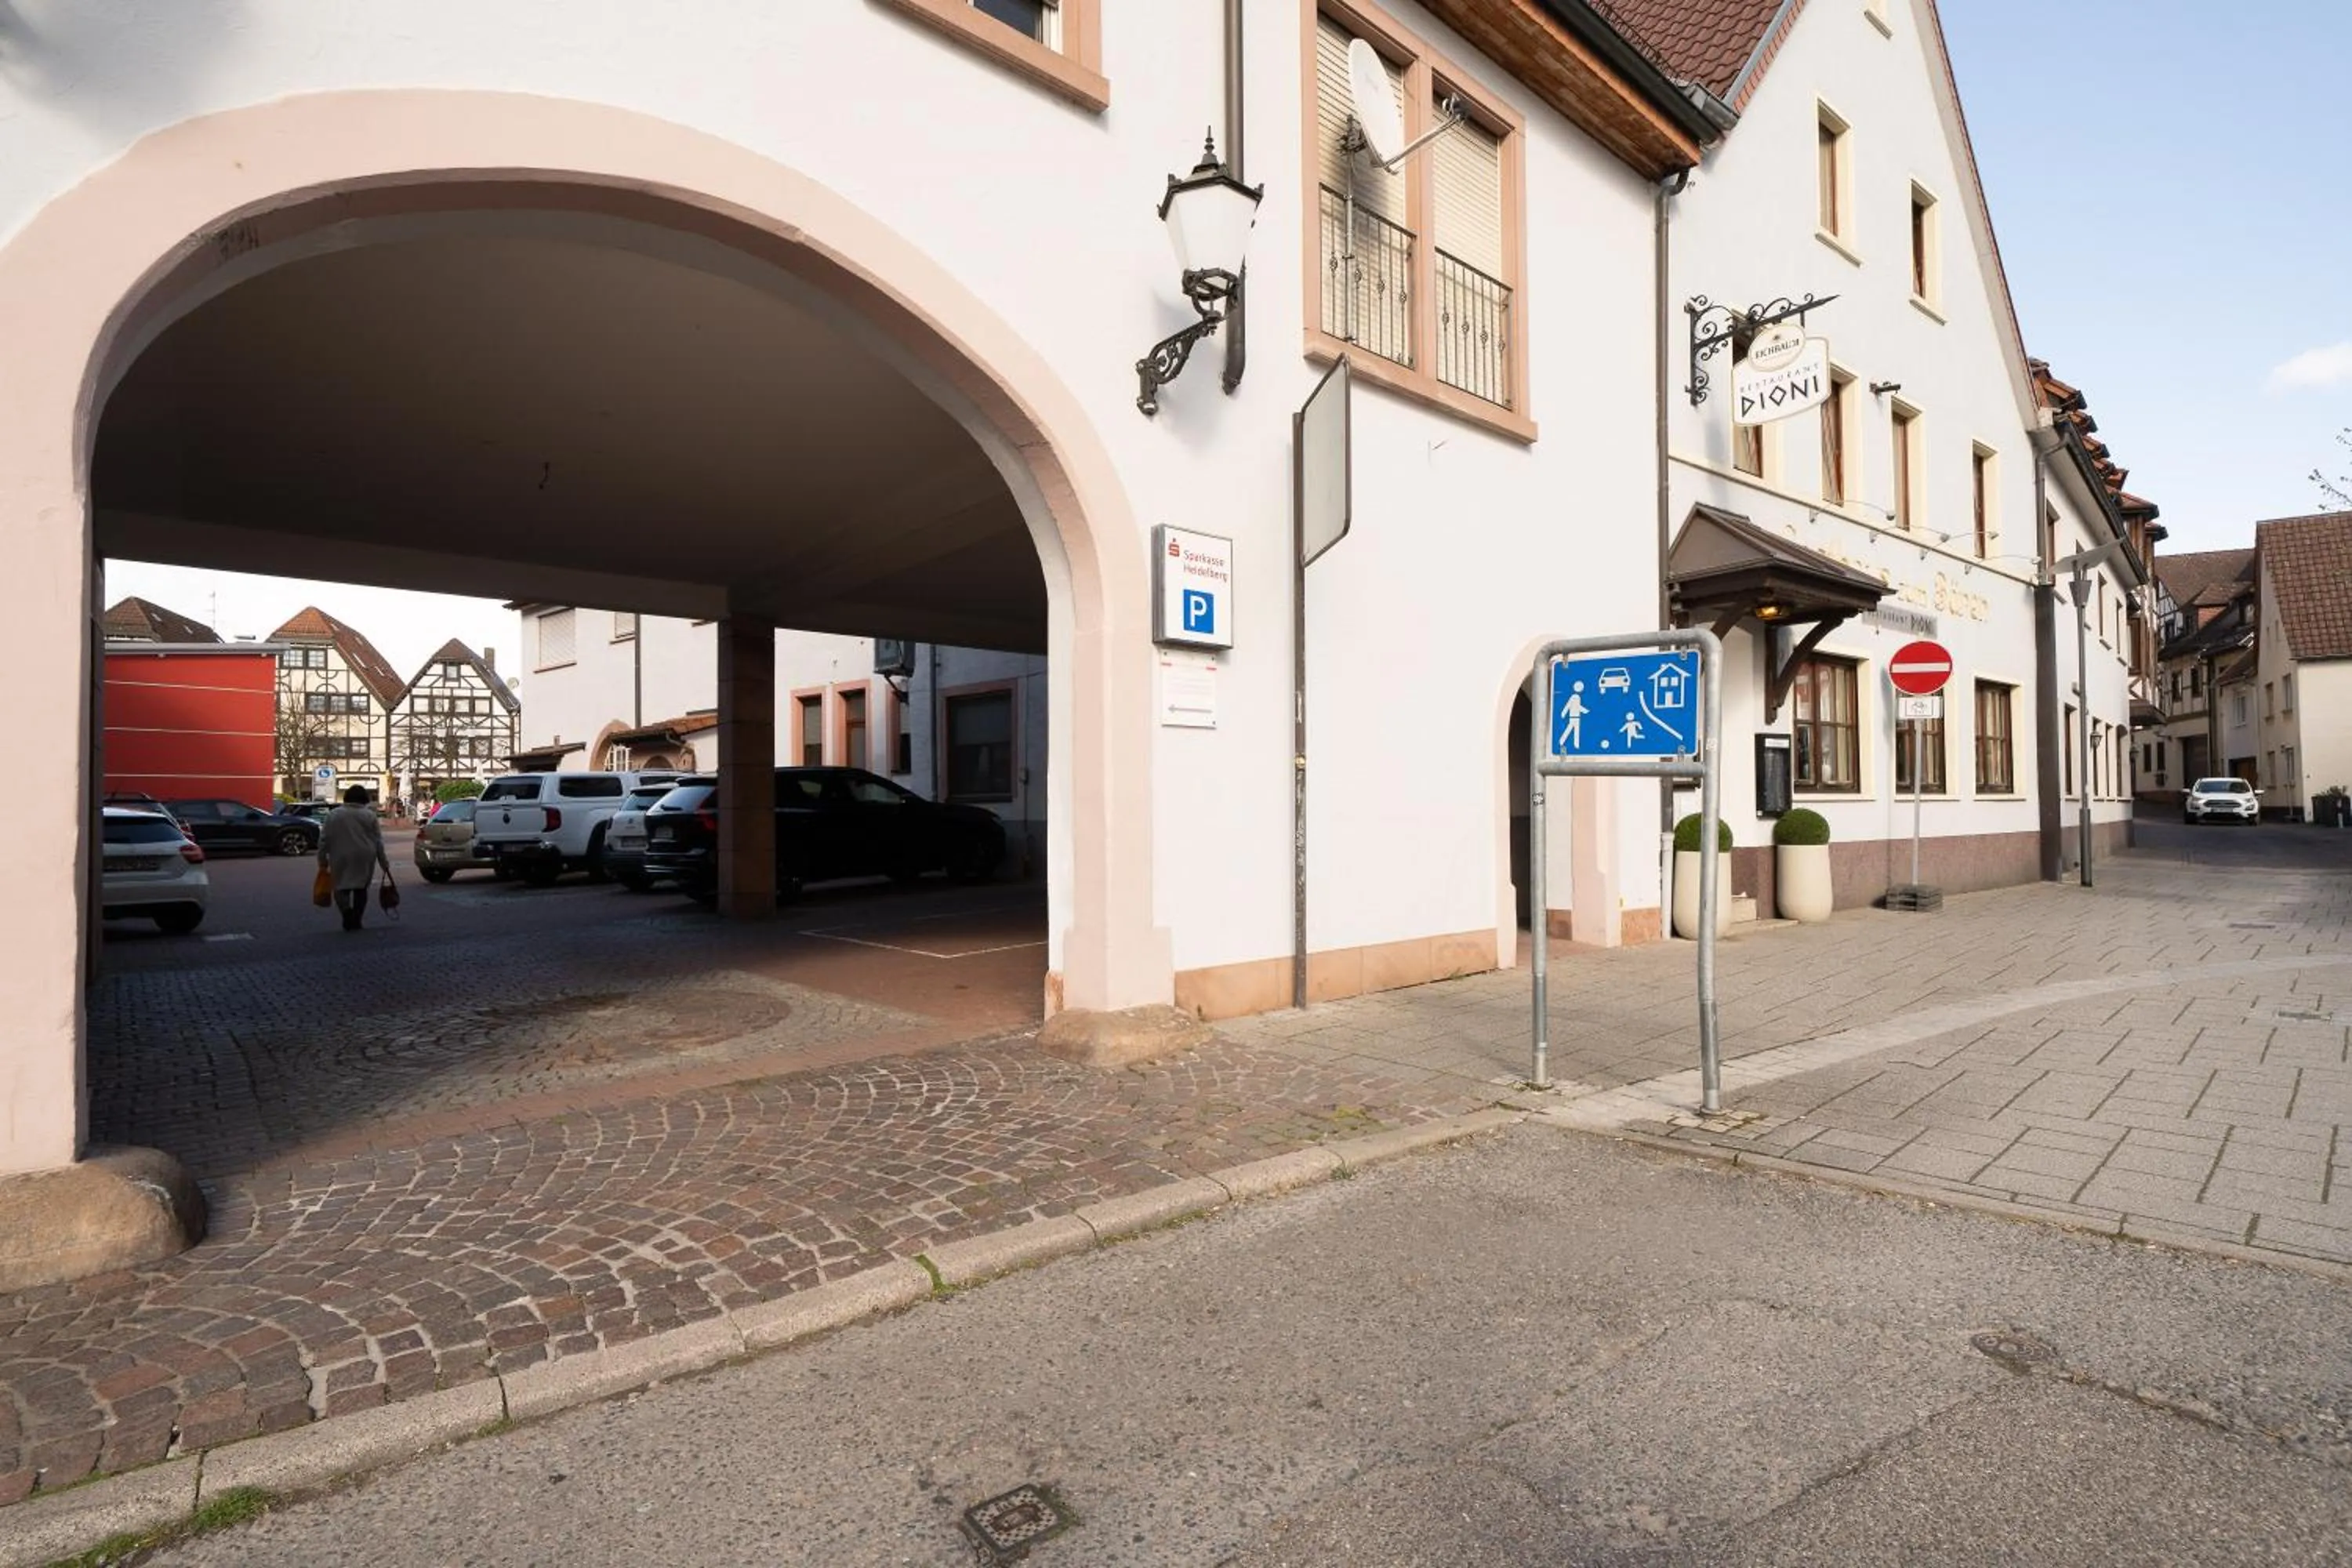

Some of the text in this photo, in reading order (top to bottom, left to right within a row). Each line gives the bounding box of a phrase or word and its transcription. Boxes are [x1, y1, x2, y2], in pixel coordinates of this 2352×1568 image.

[1740, 362, 1820, 394] RESTAURANT
[1741, 375, 1819, 418] DIONI
[1183, 550, 1225, 567] Sparkasse
[1183, 562, 1229, 583] Heidelberg
[1189, 595, 1207, 627] P
